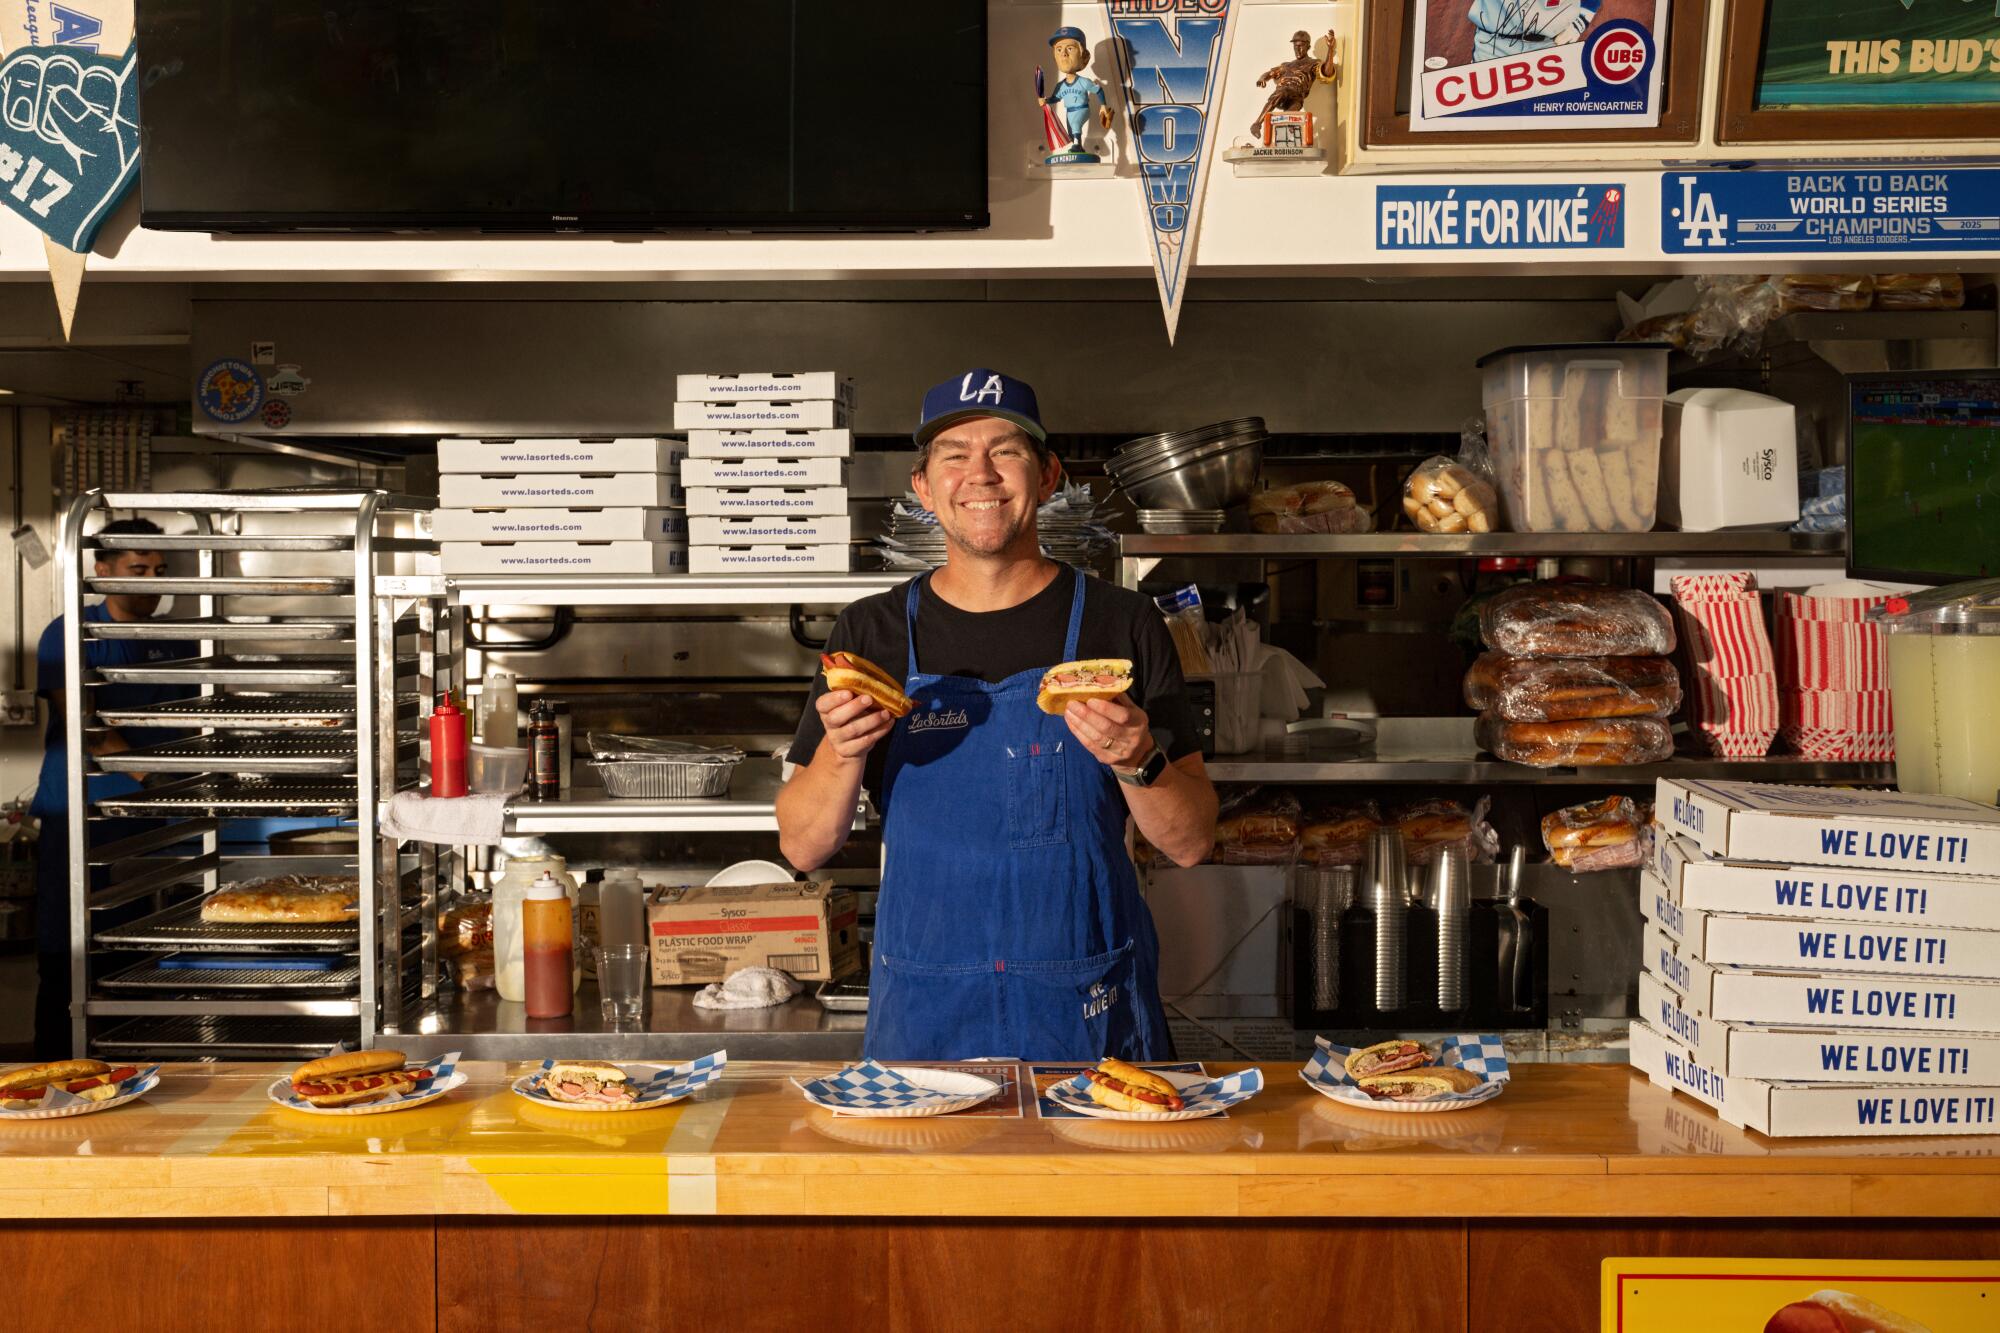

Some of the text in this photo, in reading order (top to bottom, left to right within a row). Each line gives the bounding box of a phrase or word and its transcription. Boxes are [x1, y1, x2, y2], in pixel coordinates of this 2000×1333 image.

[1594, 31, 1644, 82] CUBS
[1826, 39, 1900, 74] THIS
[1435, 54, 1566, 108] CUBS
[1533, 101, 1643, 112] HENRY ROWENGARTNER
[1583, 92, 1590, 101] P
[1787, 174, 1949, 193] BACK TO BACK
[1382, 187, 1589, 244] FRIKÉ FOR KIKÉ
[1679, 176, 1728, 246] LA
[1789, 196, 1948, 214] WORLD SERIES
[1754, 223, 1777, 231] 2024
[1805, 218, 1931, 235] CHAMPIONS
[1960, 221, 1982, 229] 2025
[1828, 236, 1842, 244] LOS
[1843, 235, 1874, 244] ANGELES
[710, 384, 801, 392] www.lasorteds.com
[959, 372, 1004, 405] LA
[707, 412, 799, 420] www.lasorteds.com
[501, 453, 593, 461] www.lasorteds.com
[1762, 449, 1773, 480] Sysco
[492, 523, 582, 531] www.lasorteds.com
[722, 527, 817, 535] www.lasorteds.com
[501, 556, 591, 564] www.lasorteds.com
[722, 555, 815, 563] www.lasorteds.com
[1674, 796, 1682, 822] WE
[1683, 801, 1696, 829] LOVE
[1821, 829, 1967, 863] WE LOVE IT!
[1775, 880, 1927, 914] WE LOVE IT!
[721, 908, 747, 918] Sysco
[658, 934, 753, 947] PLASTIC FOOD WRAP
[1799, 932, 1946, 964] WE LOVE IT!
[1661, 948, 1690, 992] WE LOVE IT!
[1807, 988, 1955, 1019] WE LOVE IT!
[1661, 999, 1699, 1047] WE LOVE IT!
[1821, 1044, 1969, 1074] WE LOVE IT!
[1665, 1051, 1724, 1102] WE LOVE IT!
[1857, 1097, 1994, 1124] WE LOVE IT!
